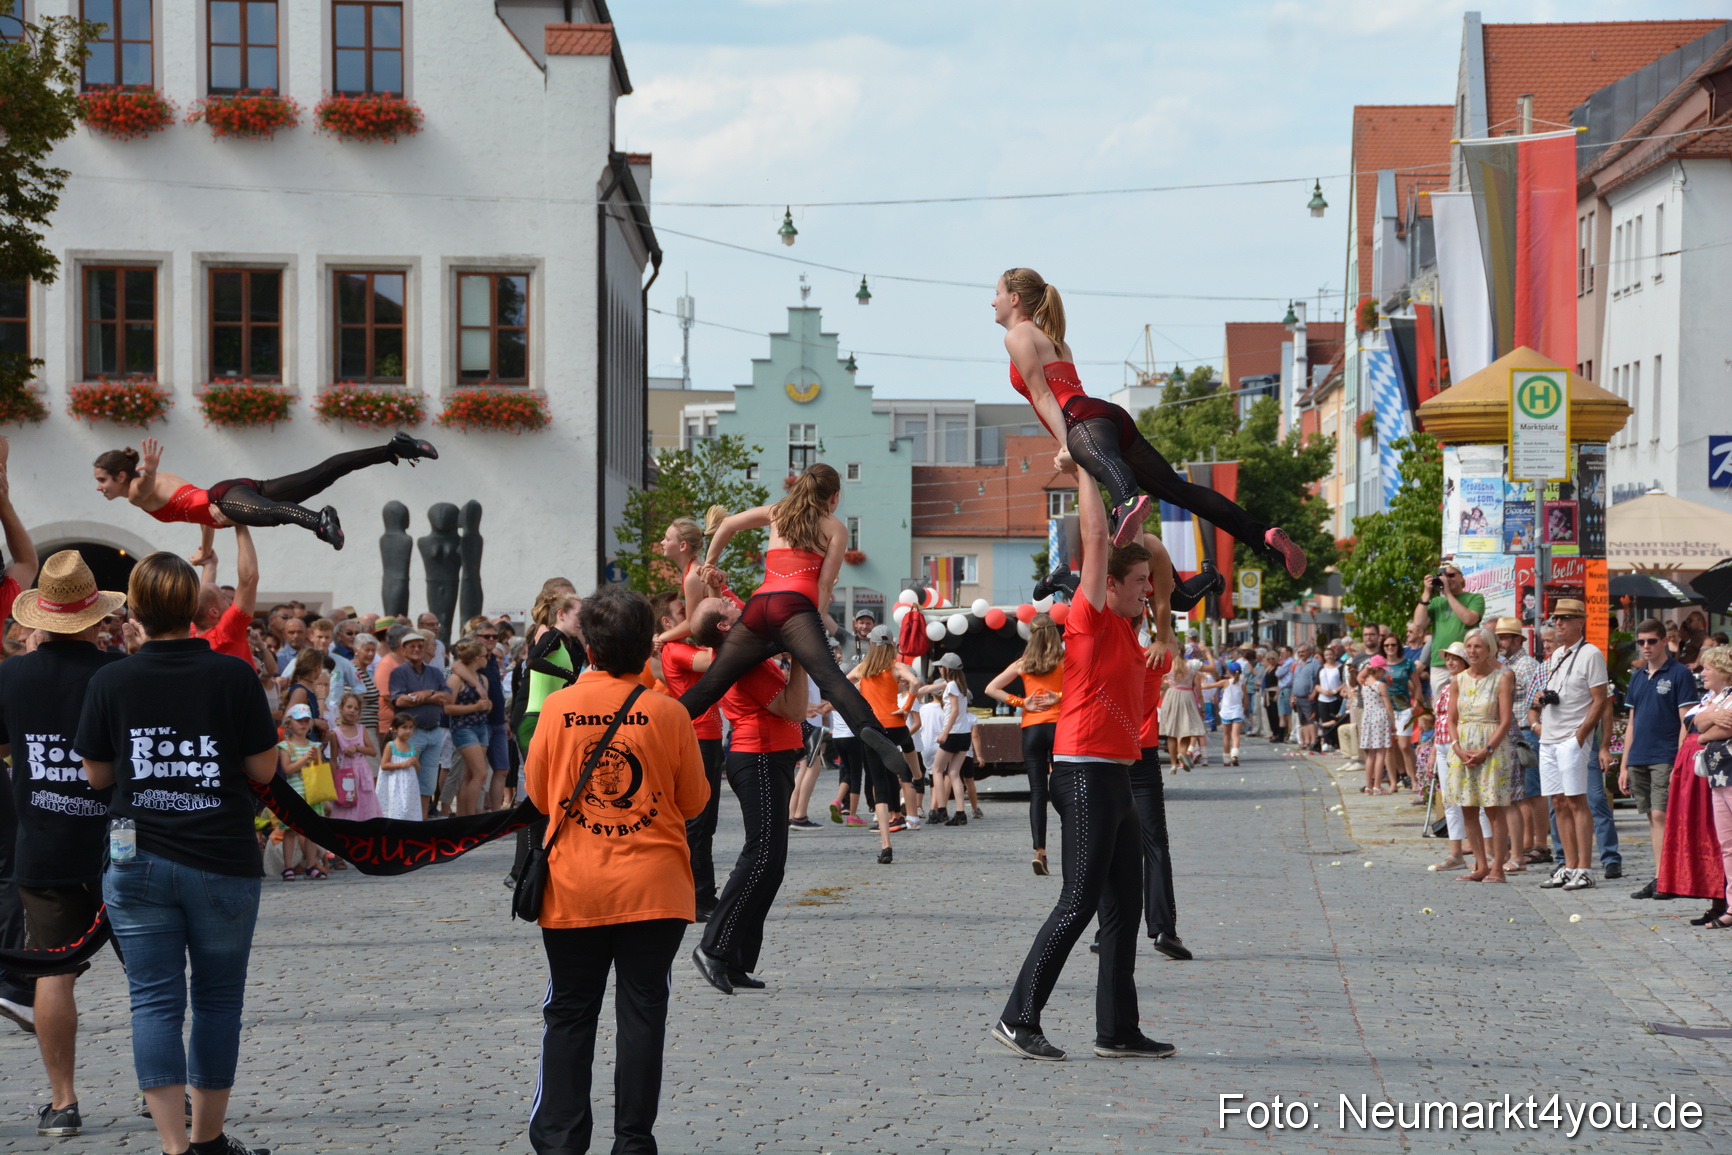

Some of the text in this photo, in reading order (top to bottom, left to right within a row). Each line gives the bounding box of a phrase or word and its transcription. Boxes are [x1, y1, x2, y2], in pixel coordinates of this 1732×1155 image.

[1520, 423, 1559, 431] Marktplatz
[1608, 540, 1720, 549] Neumarkter
[563, 711, 649, 728] Fancub
[25, 733, 67, 742] www.
[129, 727, 177, 737] www.
[26, 742, 84, 762] Roc
[129, 735, 219, 759] Rock
[27, 760, 89, 782] Danc
[130, 758, 221, 780] Dance
[194, 778, 221, 788] .de
[31, 791, 108, 816] Fan-Club
[131, 792, 221, 811] Fan-Club
